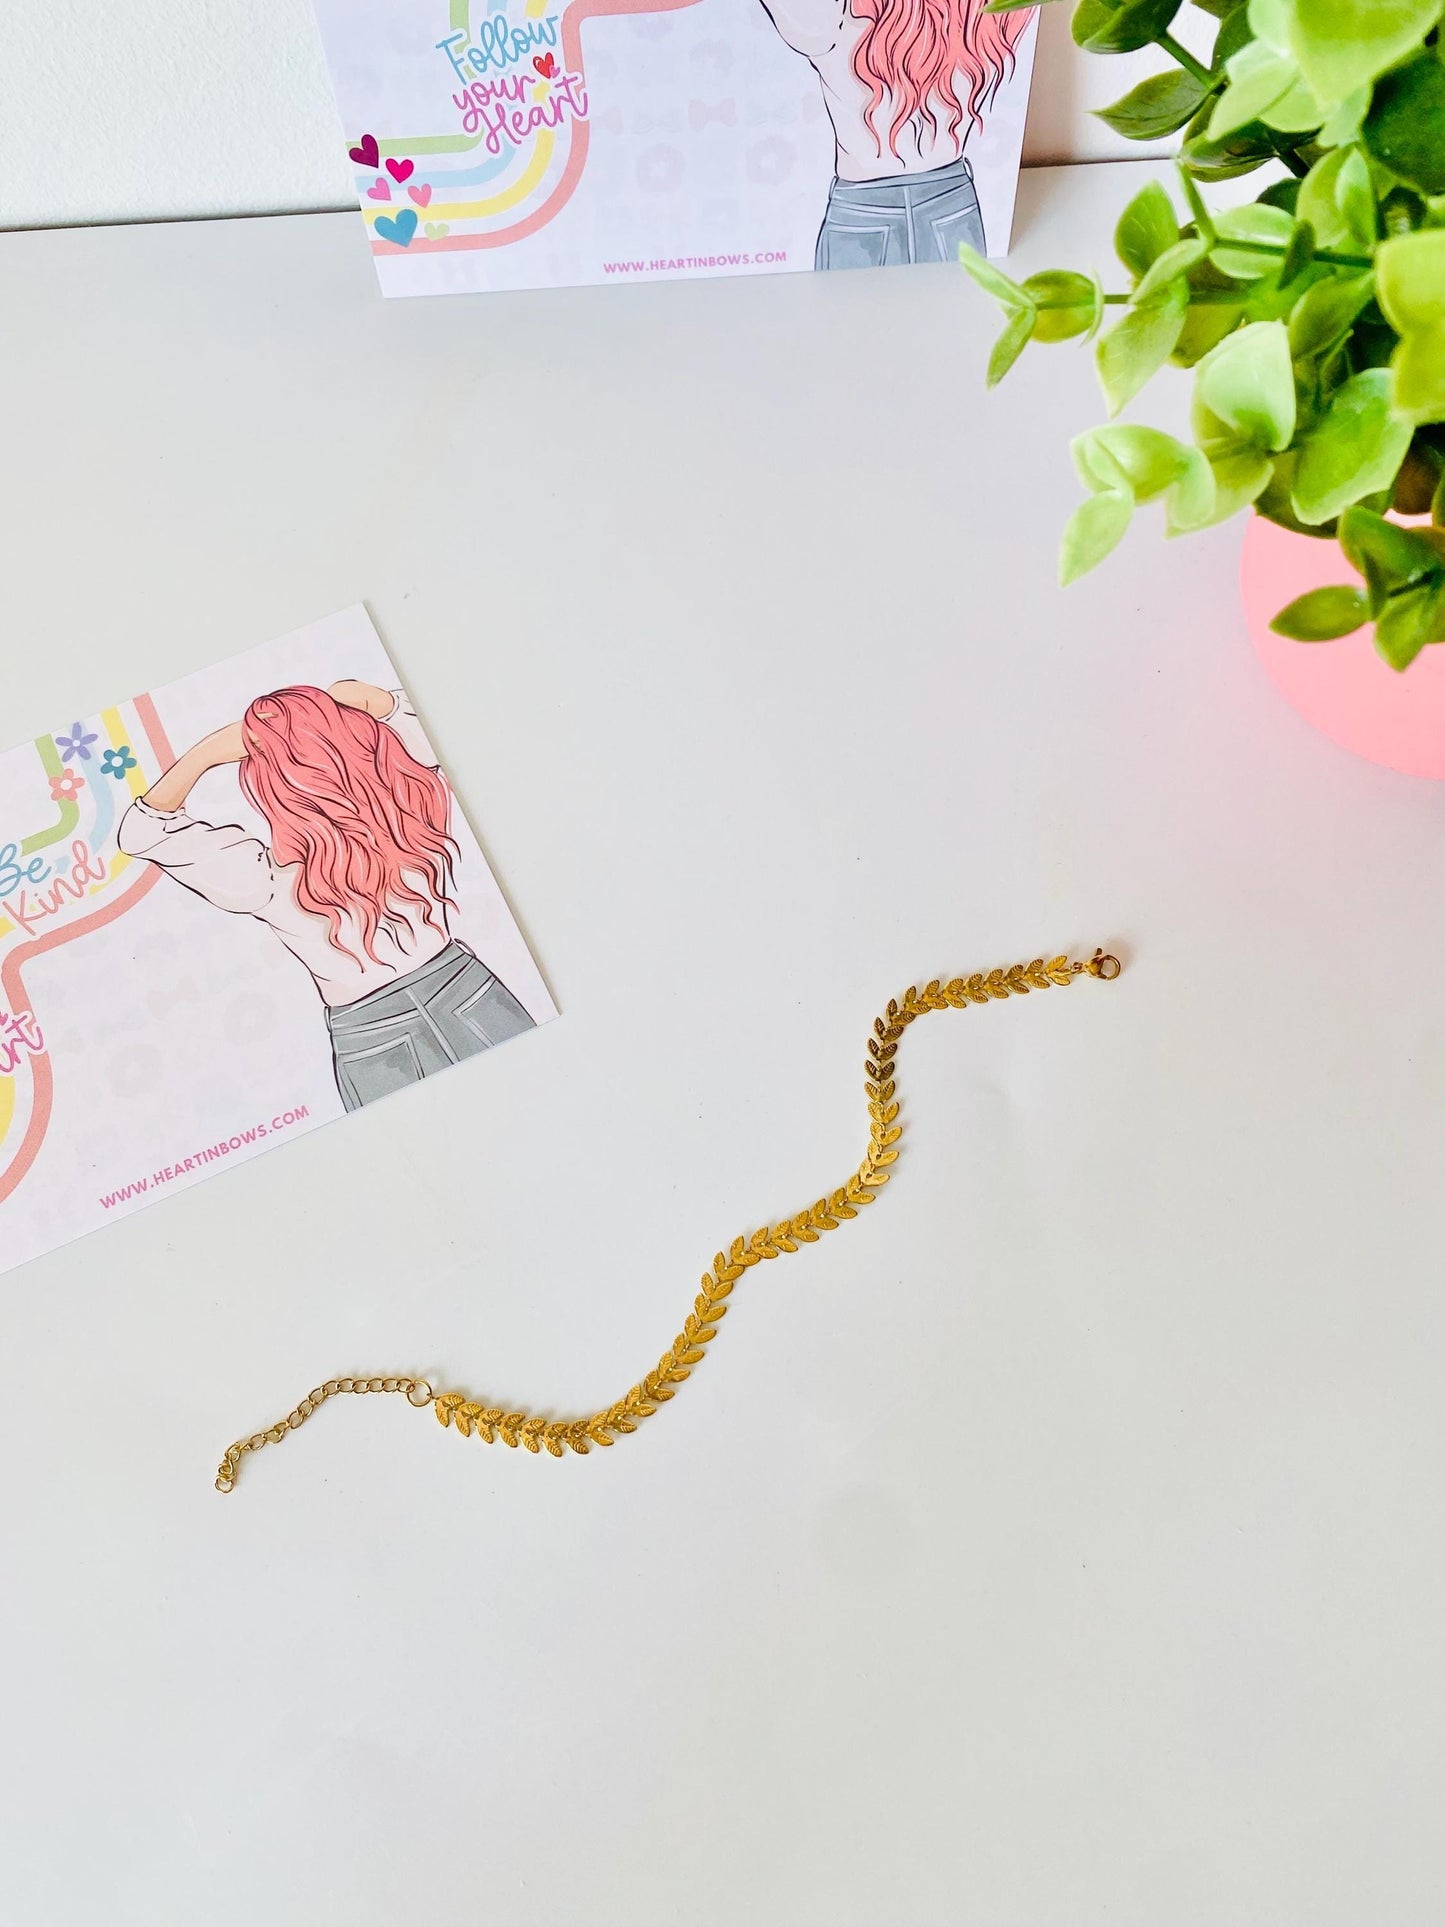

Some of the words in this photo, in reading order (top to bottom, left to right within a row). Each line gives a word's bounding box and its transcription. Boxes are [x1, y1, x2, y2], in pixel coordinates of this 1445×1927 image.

[435, 14, 559, 86] Follow
[452, 74, 536, 133] your
[477, 76, 589, 154] Heart
[603, 251, 787, 274] WWW.HEARTINBOWS.COM
[0, 843, 52, 897] Be
[2, 839, 106, 936] Kind
[99, 1105, 310, 1209] WWW.HEARTINBOWS.COM
